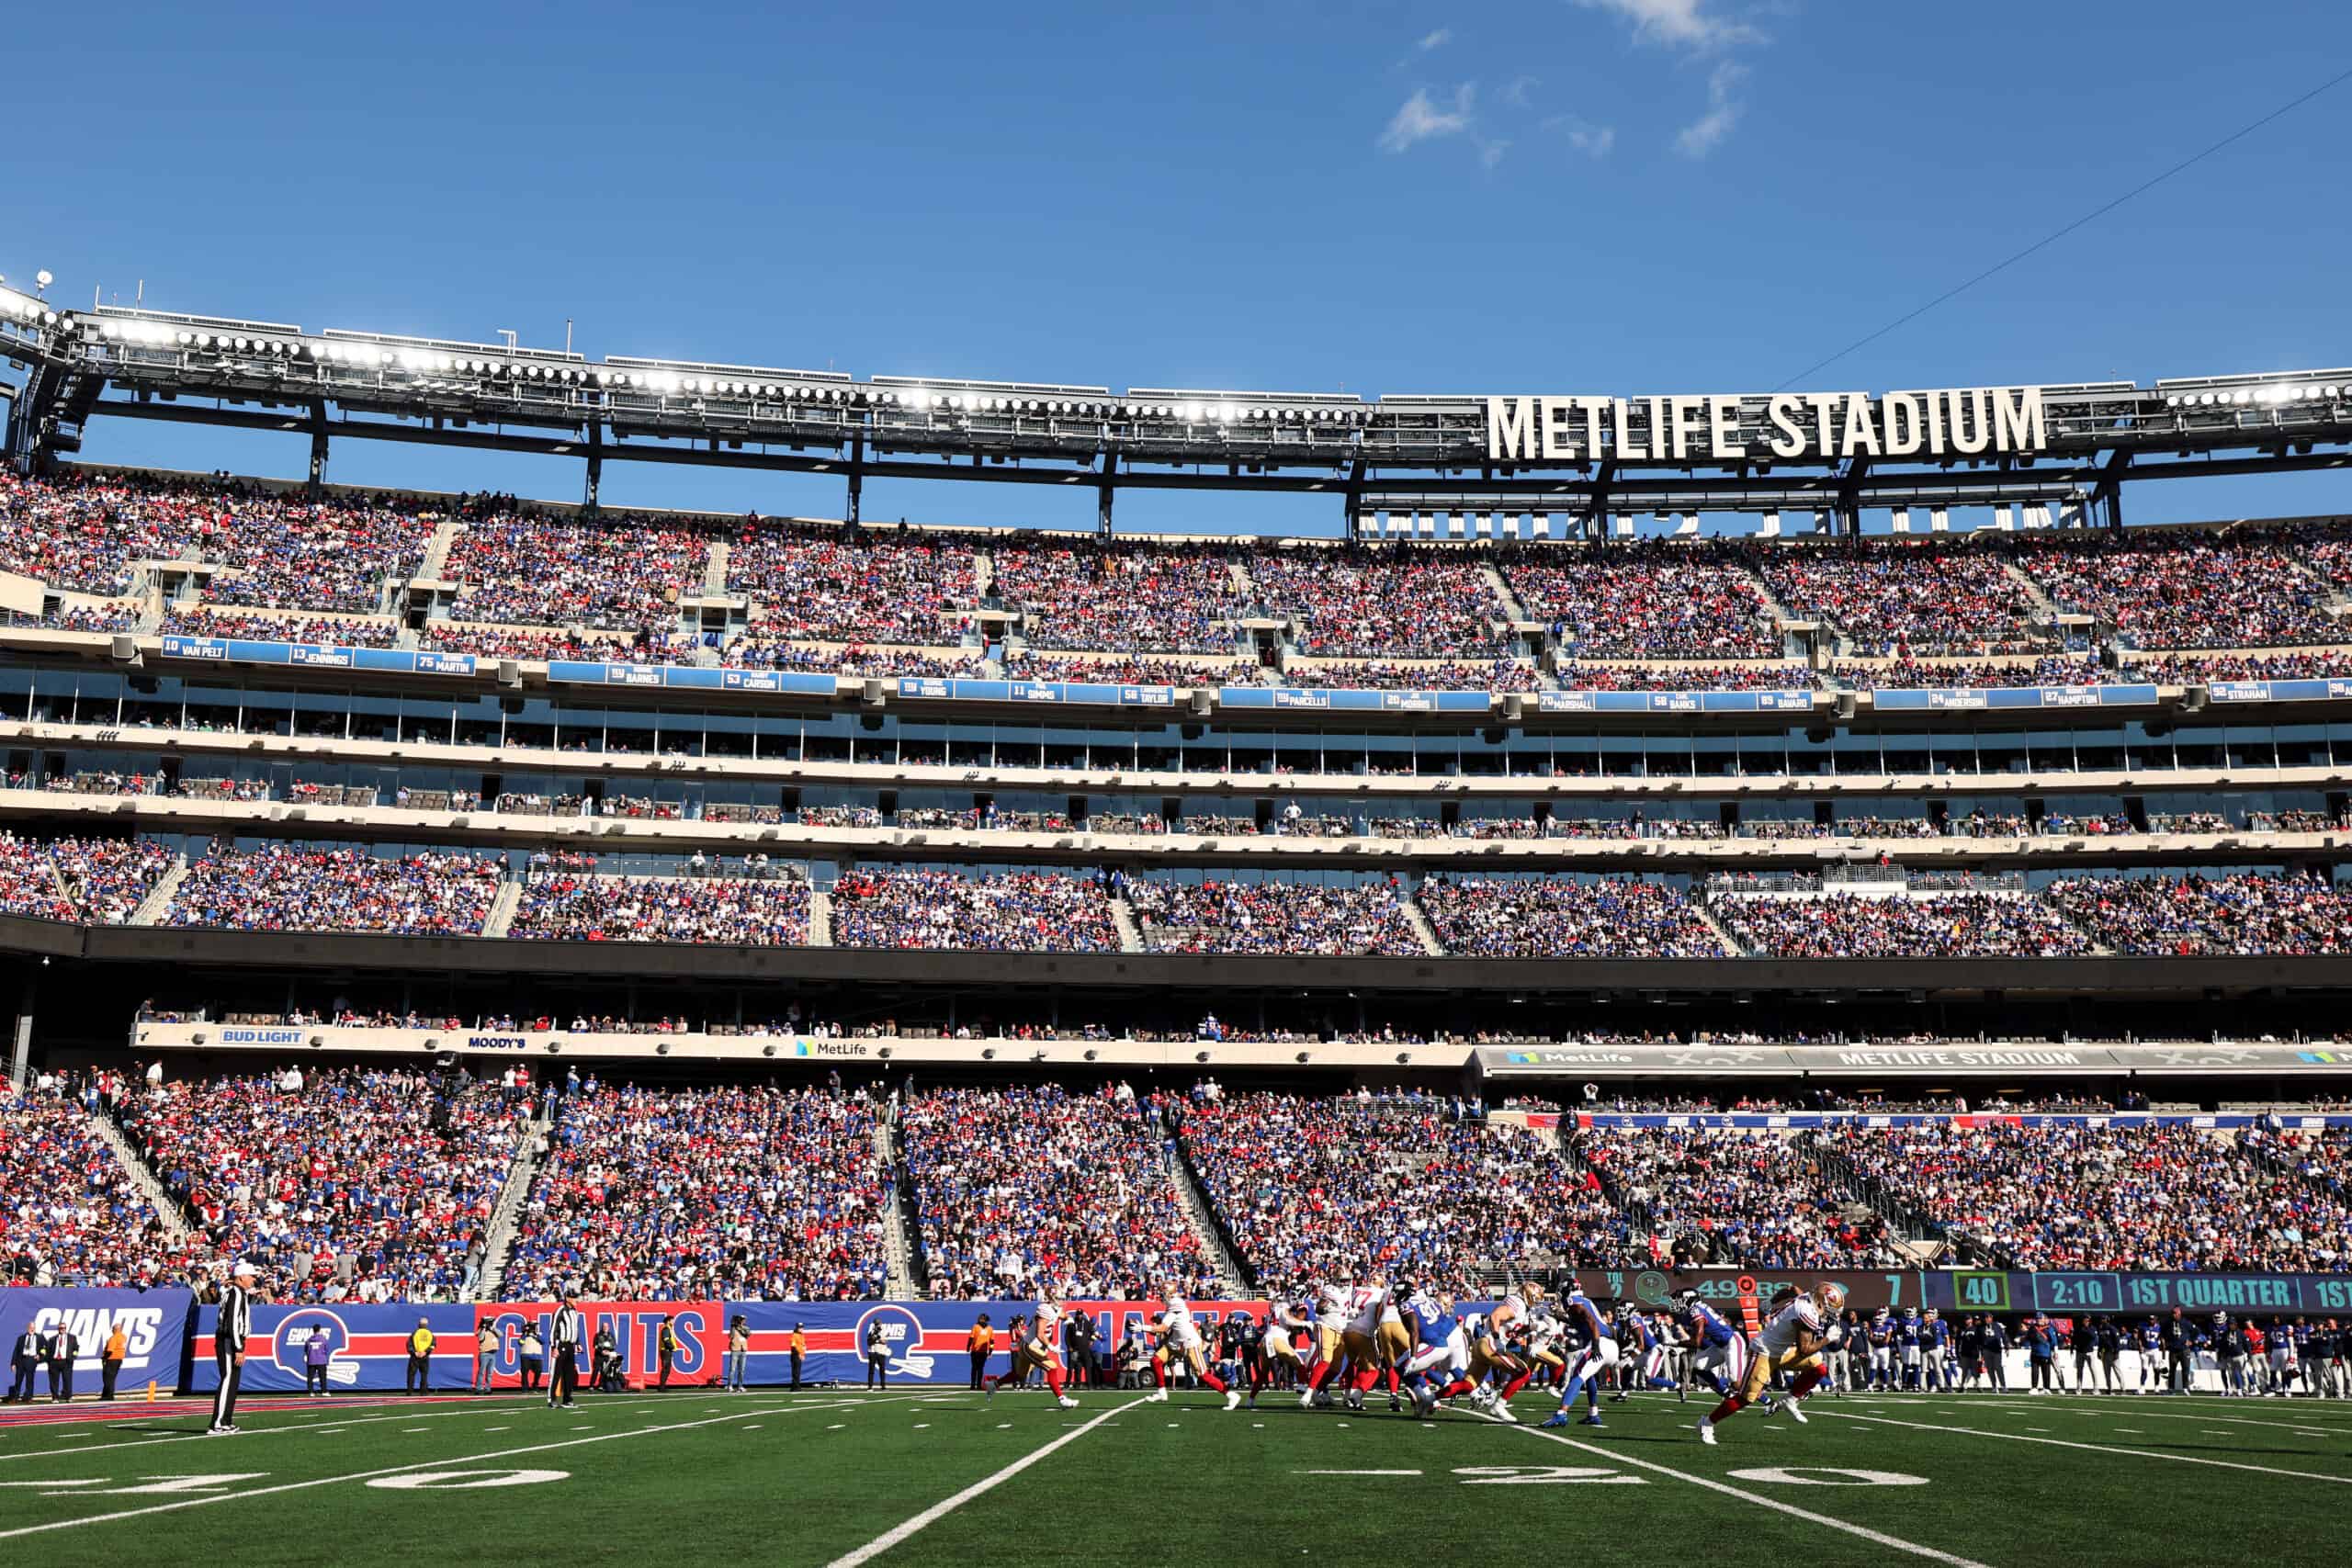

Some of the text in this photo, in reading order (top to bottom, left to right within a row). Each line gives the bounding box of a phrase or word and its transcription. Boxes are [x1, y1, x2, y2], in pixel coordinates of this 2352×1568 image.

[1487, 389, 2047, 459] METLIFE STADIUM
[165, 640, 178, 650] 10
[182, 646, 223, 658] VAN PELT
[293, 649, 306, 659] 13
[420, 657, 434, 667] 75
[435, 661, 469, 672] MARTIN
[2045, 691, 2058, 701] 27
[2228, 690, 2267, 700] STRAHAN
[1289, 697, 1327, 706] PARCELLS
[223, 1031, 302, 1043] BUD LIGHT
[469, 1037, 526, 1049] MOODY'S
[817, 1043, 866, 1055] MetLife
[1544, 1053, 1633, 1063] MetLife
[1838, 1052, 2081, 1066] METLIFE STADIUM
[1697, 1280, 1792, 1299] 49RS
[1885, 1274, 1901, 1305] 7
[1965, 1277, 1998, 1304] 40
[2051, 1279, 2104, 1305] 2:10
[2128, 1278, 2291, 1308] 1ST QUARTER
